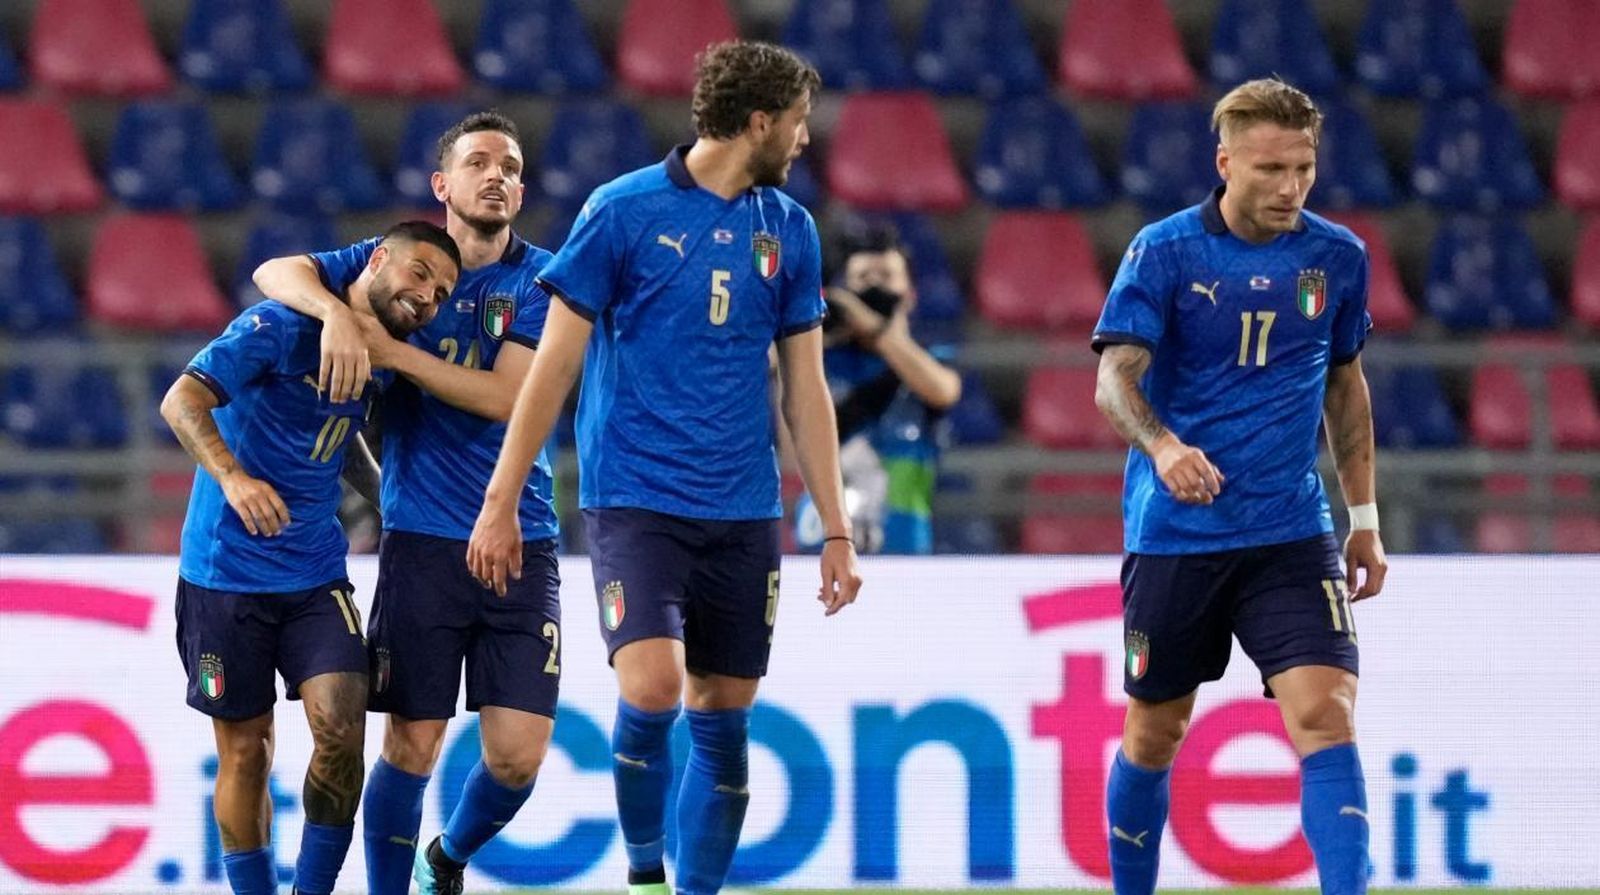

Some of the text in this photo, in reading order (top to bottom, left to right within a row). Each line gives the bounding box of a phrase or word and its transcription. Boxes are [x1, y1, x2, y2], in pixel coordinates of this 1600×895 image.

[709, 269, 731, 326] 5
[1237, 311, 1277, 367] 17
[309, 414, 351, 463] 10
[439, 650, 1492, 887] conteit
